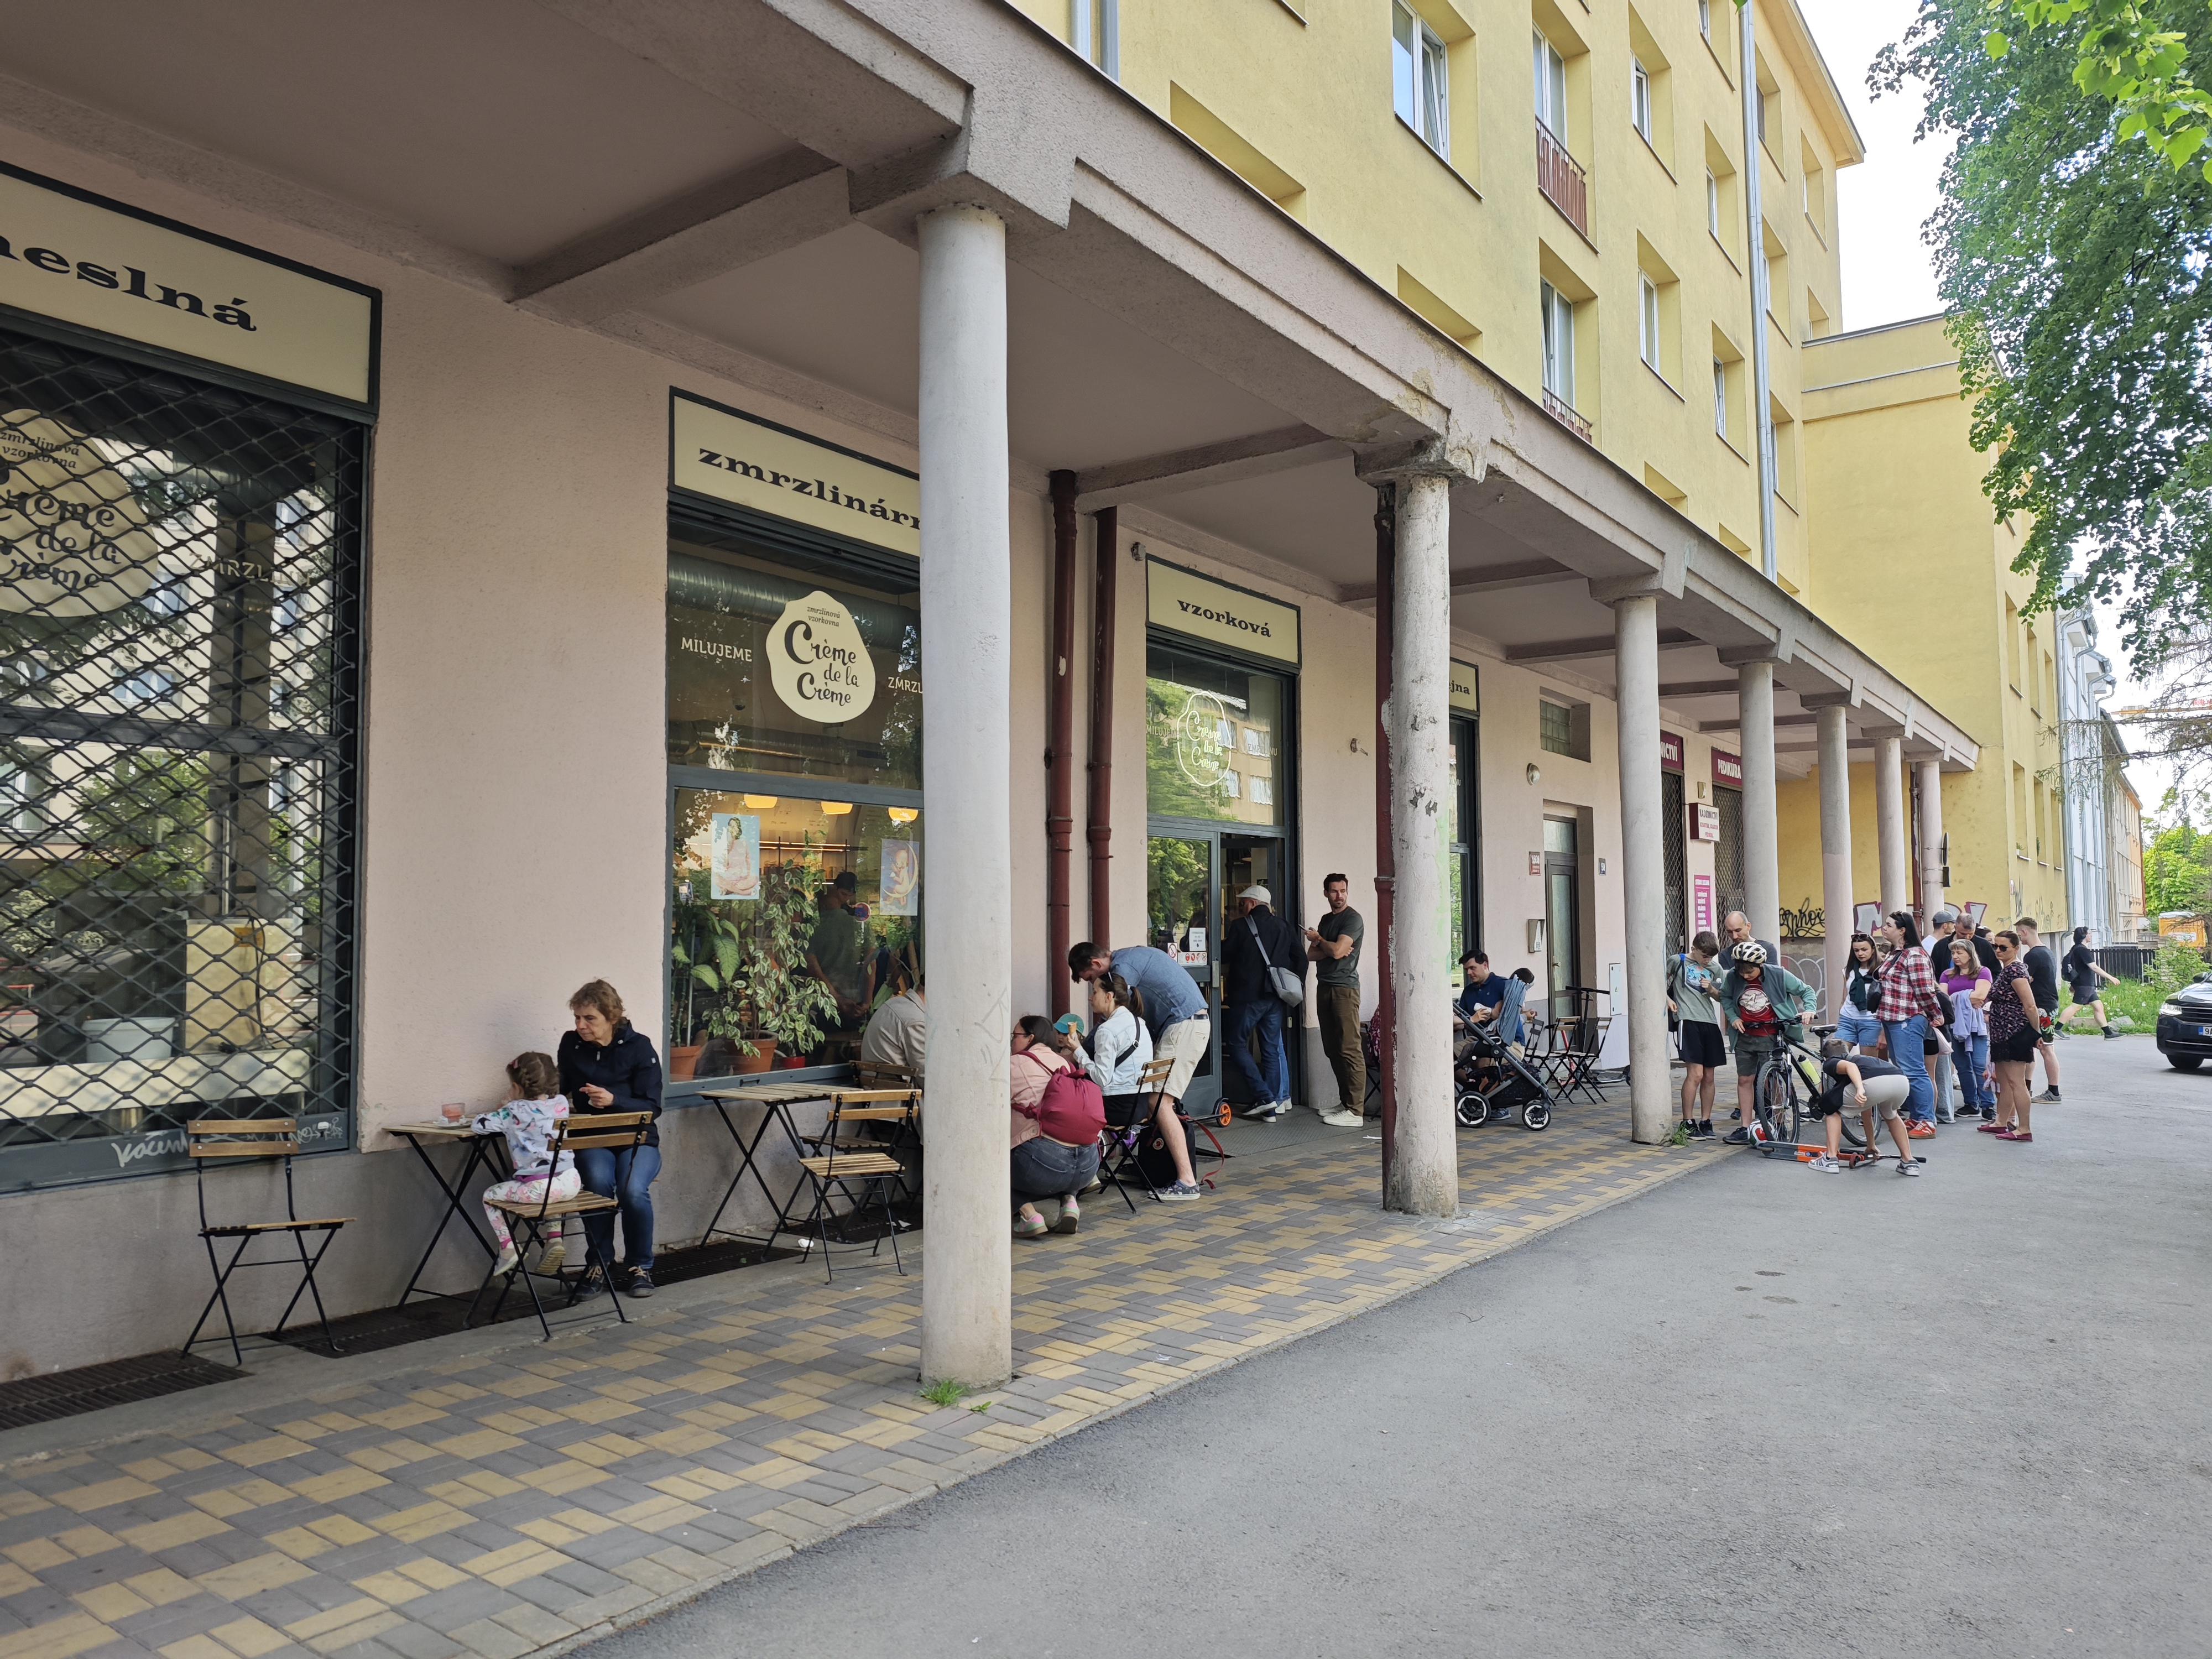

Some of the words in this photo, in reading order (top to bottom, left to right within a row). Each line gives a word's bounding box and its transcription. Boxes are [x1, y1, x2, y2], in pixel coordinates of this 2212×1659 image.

[2, 446, 77, 469] vzorkona
[36, 523, 76, 552] de
[89, 529, 122, 565] la
[807, 606, 841, 619] zmrzlinová
[807, 614, 839, 628] vzorkovna
[1177, 599, 1271, 638] vzorková
[681, 637, 752, 662] MILUJEME
[784, 620, 857, 667] Crème
[823, 662, 841, 682] de
[846, 665, 860, 687] la
[796, 672, 852, 707] Crème
[1449, 680, 1470, 695] jna
[1718, 758, 1741, 779] PEDIKÚRA
